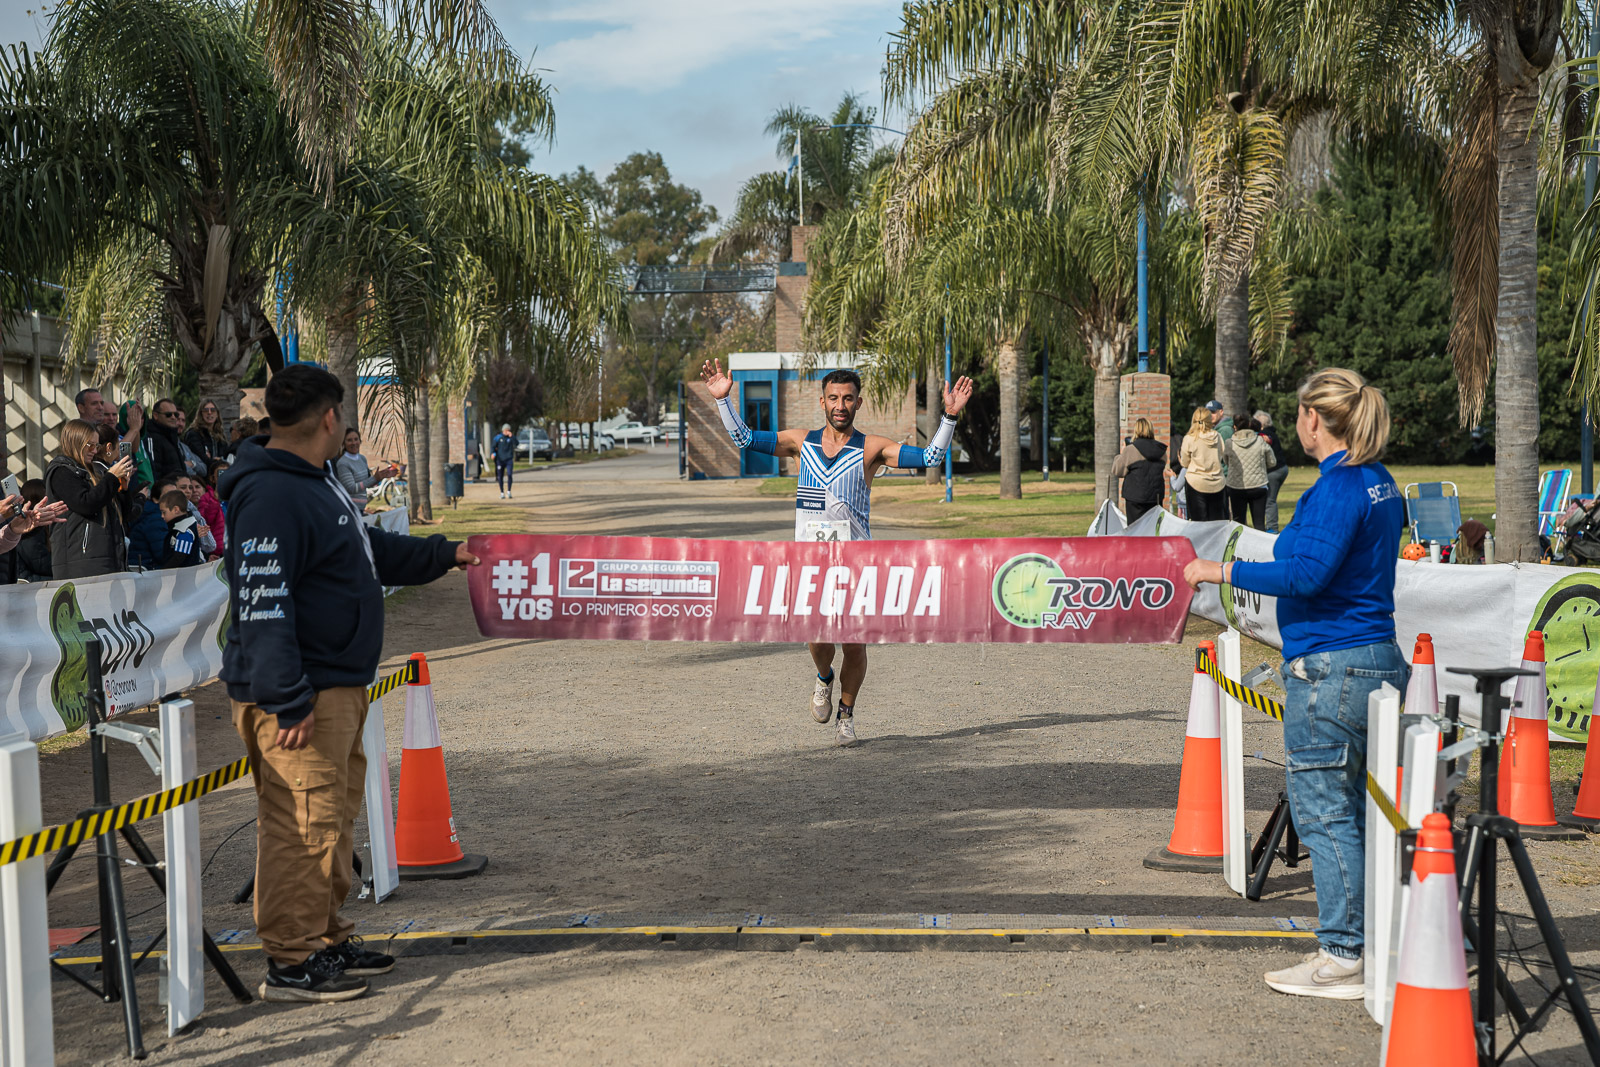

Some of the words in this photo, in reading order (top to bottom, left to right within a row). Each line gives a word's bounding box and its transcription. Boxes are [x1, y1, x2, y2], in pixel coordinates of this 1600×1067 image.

[815, 530, 841, 542] 84
[241, 537, 257, 556] El
[246, 559, 281, 583] pueblo
[492, 552, 554, 596] #1
[602, 563, 638, 572] GRUPO
[640, 563, 713, 573] ASEGURADOR
[251, 581, 289, 605] grande
[601, 575, 623, 592] La
[625, 576, 712, 595] segunda
[743, 565, 943, 617] LLEGADA
[561, 602, 582, 616] LO
[586, 602, 648, 617] PRIMERO
[651, 603, 680, 617] SOS
[684, 603, 713, 618] VOS
[1041, 612, 1097, 630] RAV
